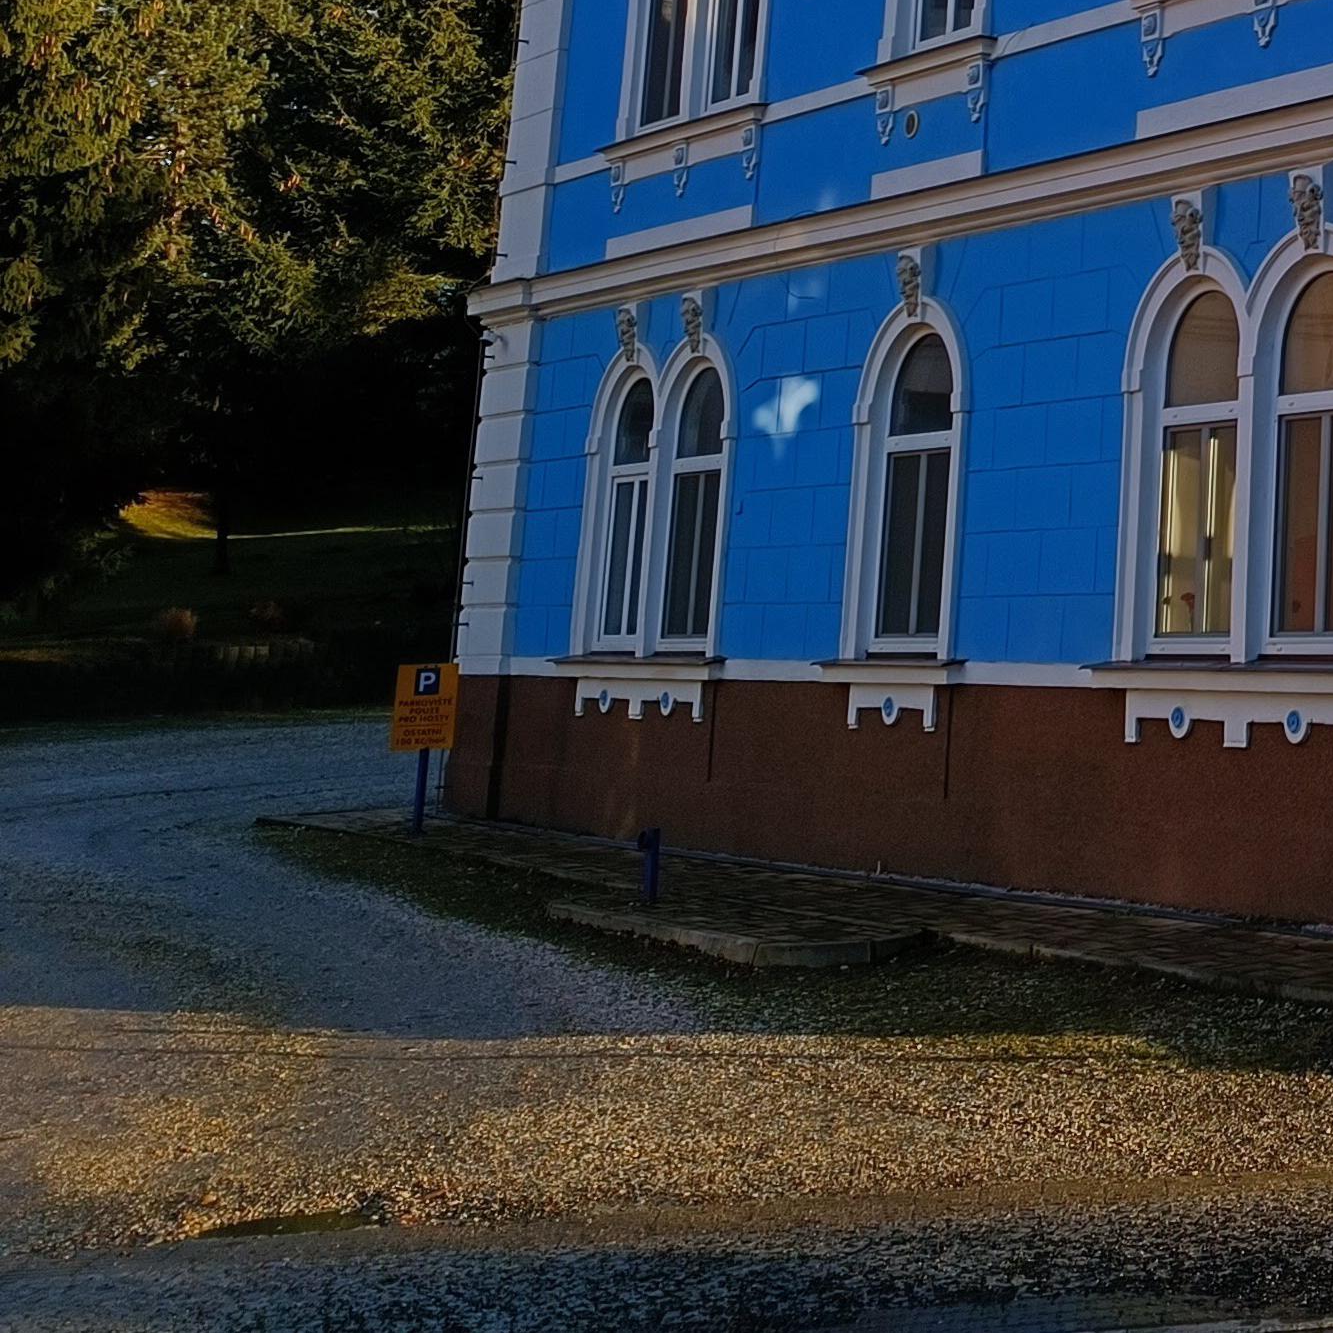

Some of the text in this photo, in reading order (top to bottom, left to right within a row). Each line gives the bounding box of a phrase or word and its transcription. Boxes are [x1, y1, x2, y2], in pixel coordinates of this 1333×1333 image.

[418, 672, 436, 692] P
[399, 714, 449, 723] PRO HOSTY
